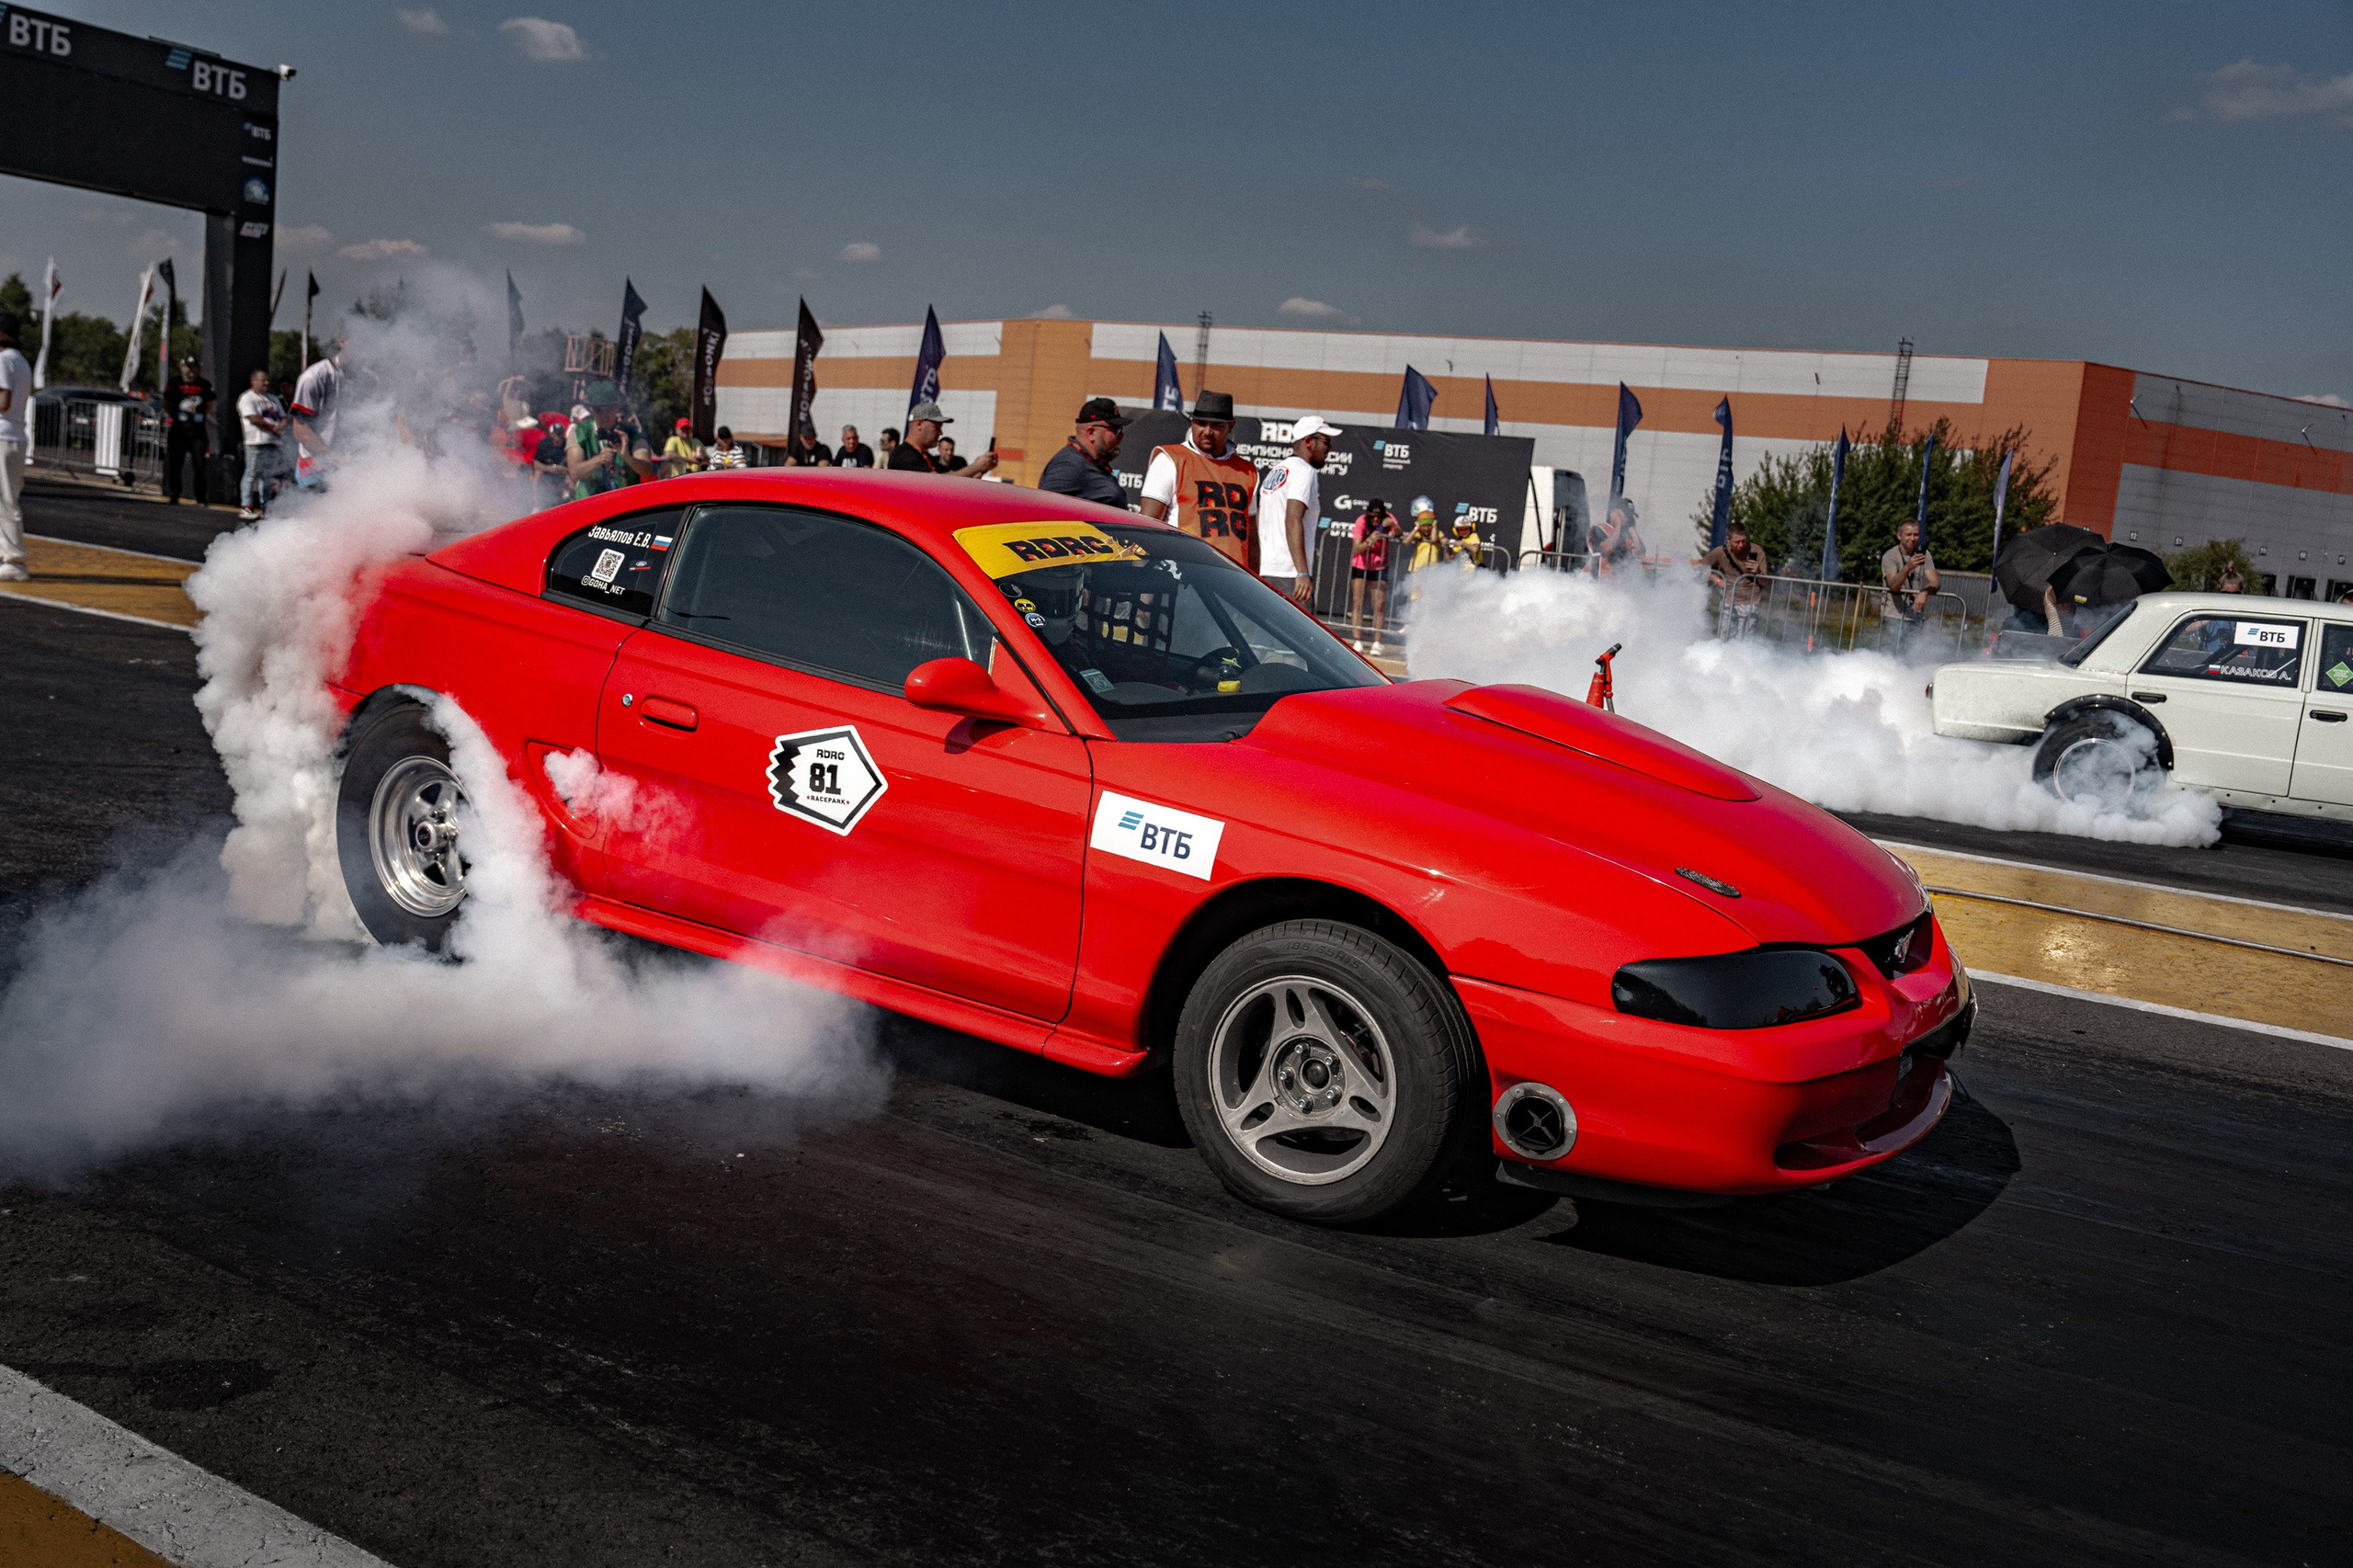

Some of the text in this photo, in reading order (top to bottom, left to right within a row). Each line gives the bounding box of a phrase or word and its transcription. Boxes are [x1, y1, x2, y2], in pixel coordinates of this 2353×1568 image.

[9, 13, 72, 57] ВТБ
[192, 60, 247, 100] ВТБ
[1161, 384, 1179, 412] ТБ
[1384, 443, 1410, 459] ВТБ
[1119, 472, 1143, 489] ВТБ
[1195, 480, 1248, 511] RD
[1198, 509, 1247, 541] RC
[1469, 506, 1498, 524] ВТБ
[632, 531, 652, 549] Е.В.
[1002, 536, 1114, 562] RDRC
[2259, 631, 2285, 643] ВТБ
[2220, 665, 2292, 681] КАЗАКОВ А.
[816, 749, 845, 761] RDRC
[809, 762, 841, 795] 81
[810, 795, 846, 805] RACEPARK
[1140, 823, 1193, 859] ВТБ
